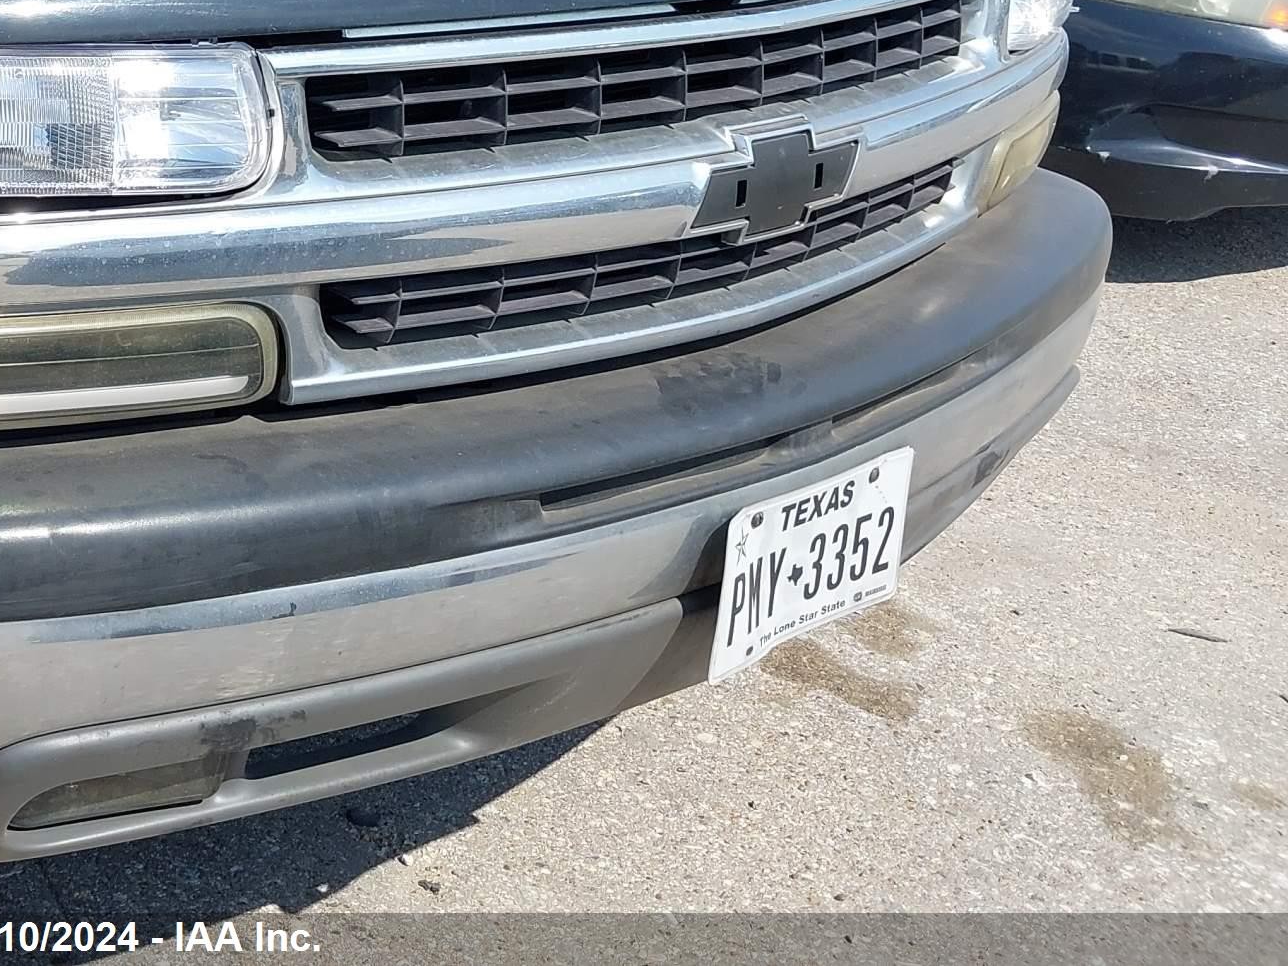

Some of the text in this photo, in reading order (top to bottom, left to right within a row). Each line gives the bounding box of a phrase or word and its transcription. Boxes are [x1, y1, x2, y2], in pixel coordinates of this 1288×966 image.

[781, 480, 855, 531] TEXAS
[759, 600, 846, 647] The Lone Star State
